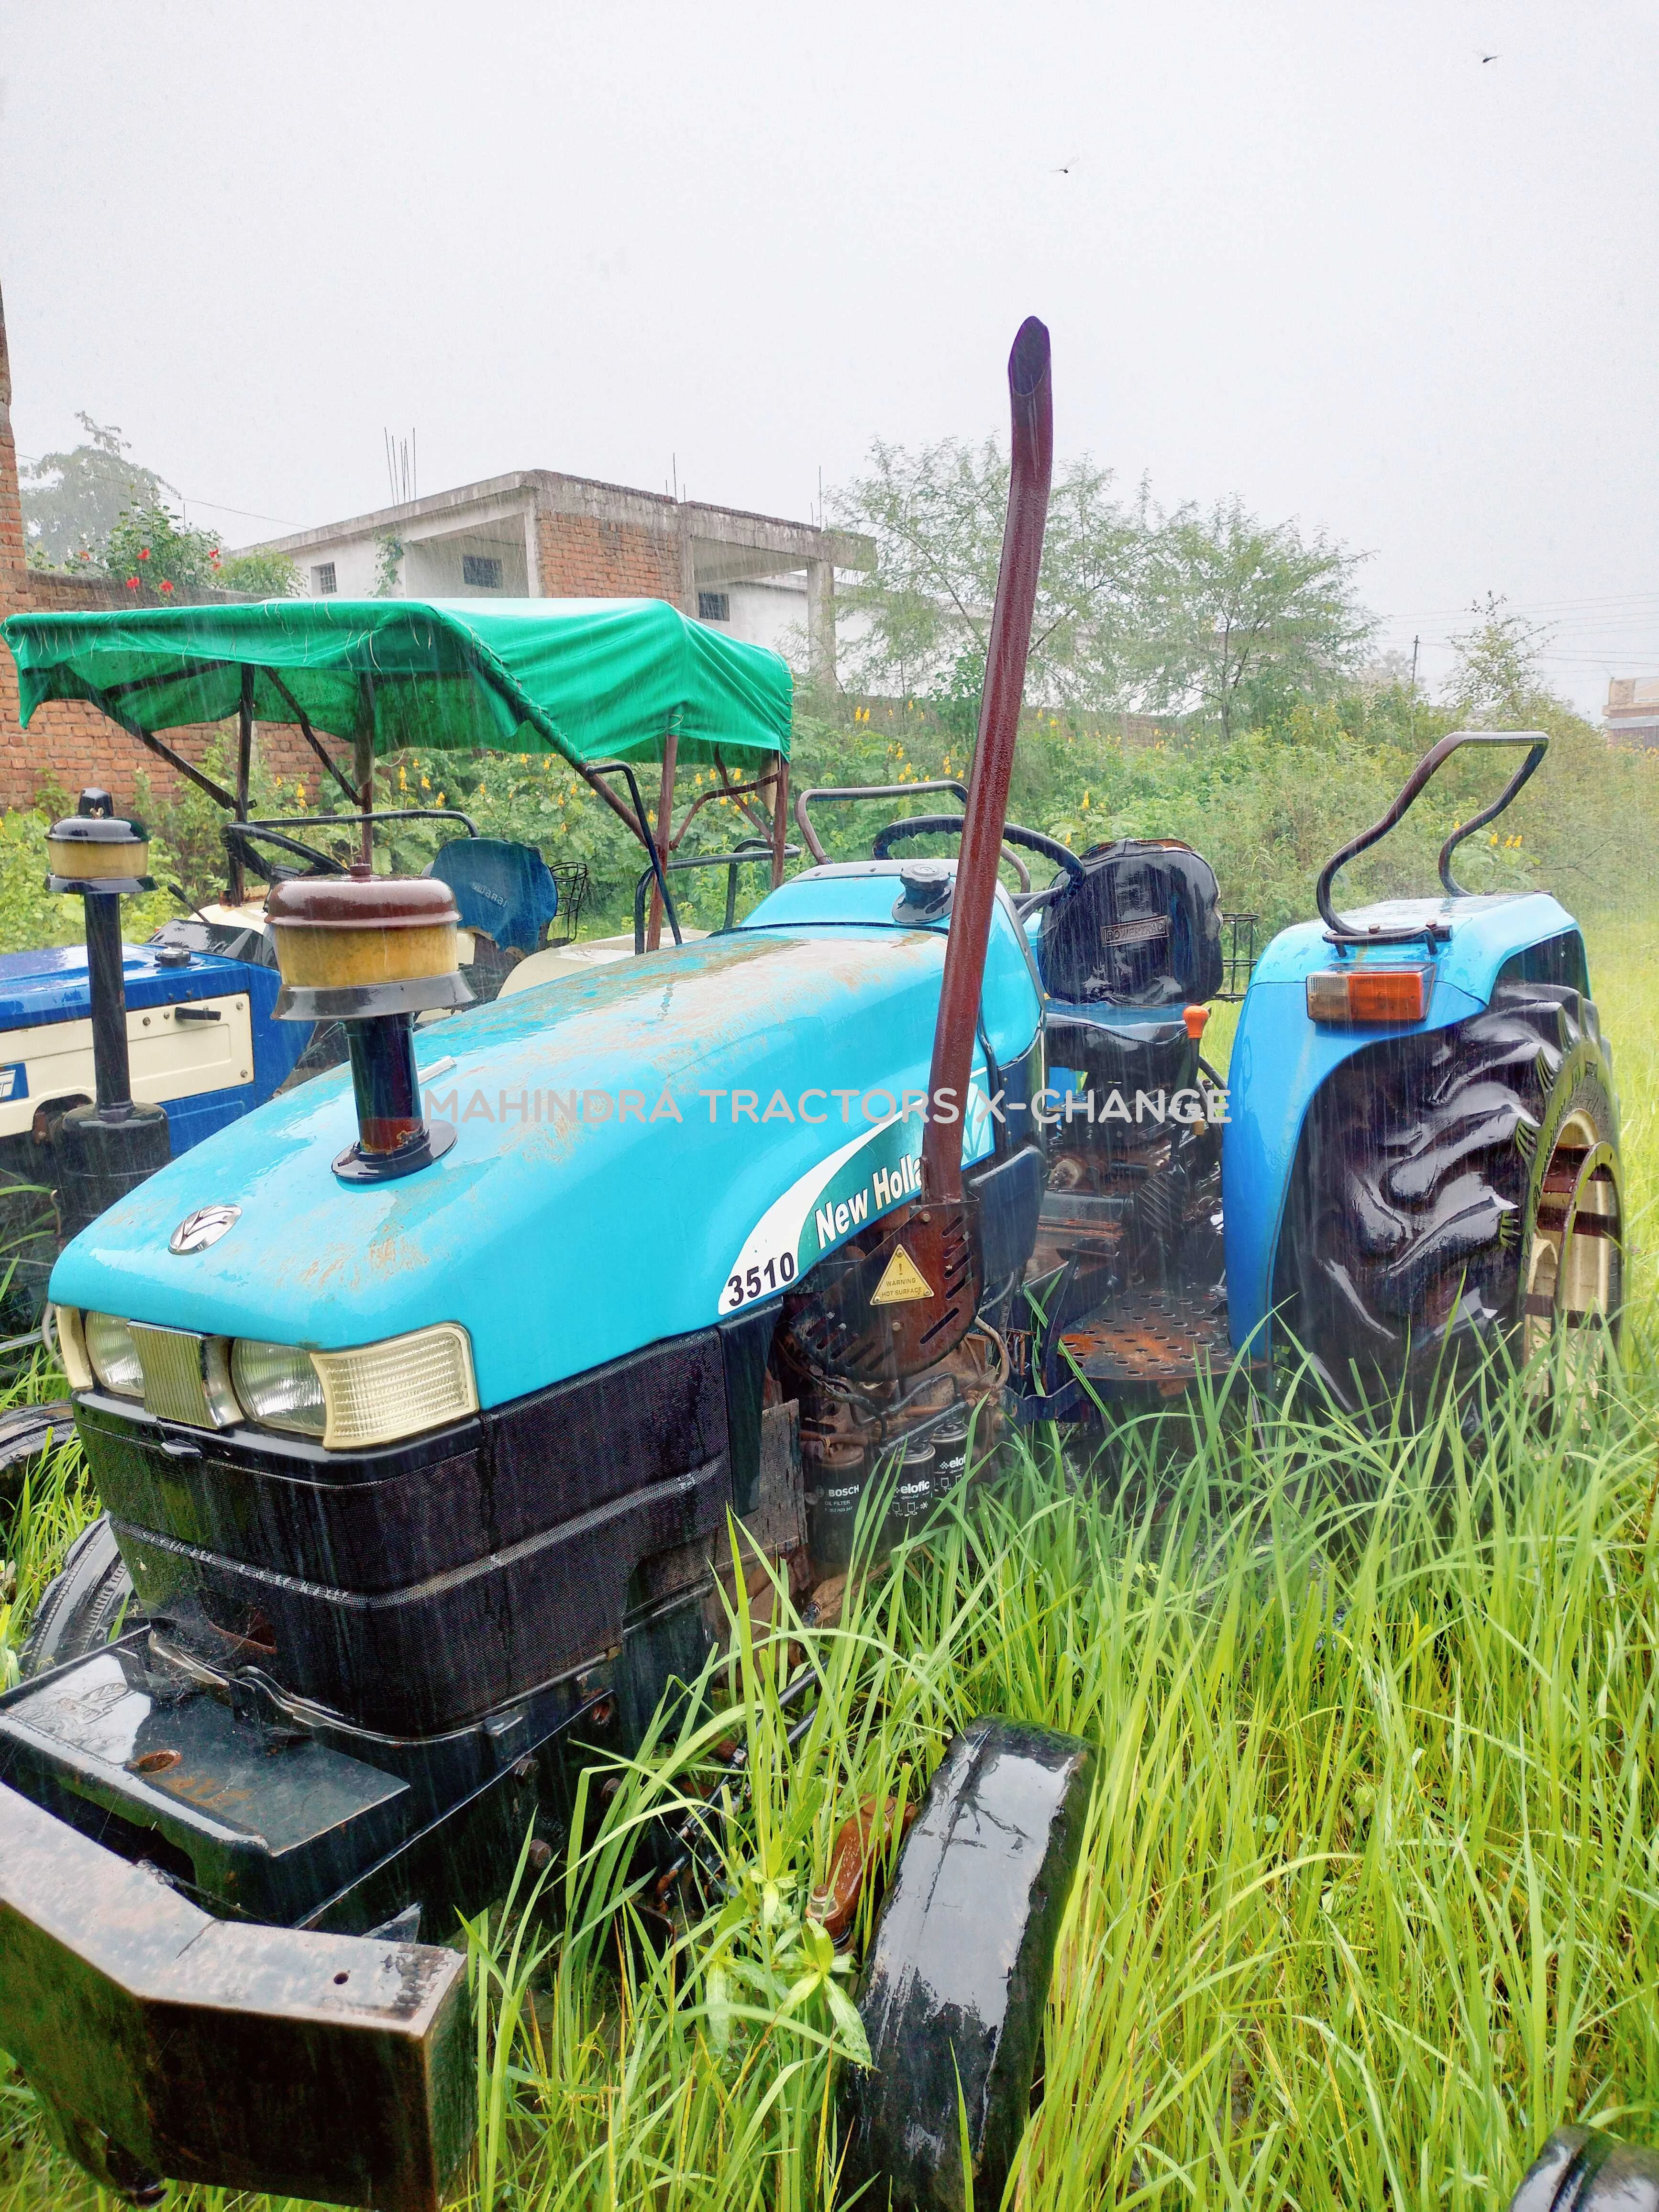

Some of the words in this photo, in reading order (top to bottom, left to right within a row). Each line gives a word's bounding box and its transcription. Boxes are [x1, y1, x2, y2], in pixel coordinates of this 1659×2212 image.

[815, 1188, 868, 1250] New
[872, 1153, 922, 1210] Holla
[728, 1252, 795, 1306] 3510
[886, 1278, 916, 1286] WARNING
[895, 1287, 922, 1295] SURFACE
[829, 1484, 860, 1497] BOSCH
[900, 1480, 930, 1494] elofic
